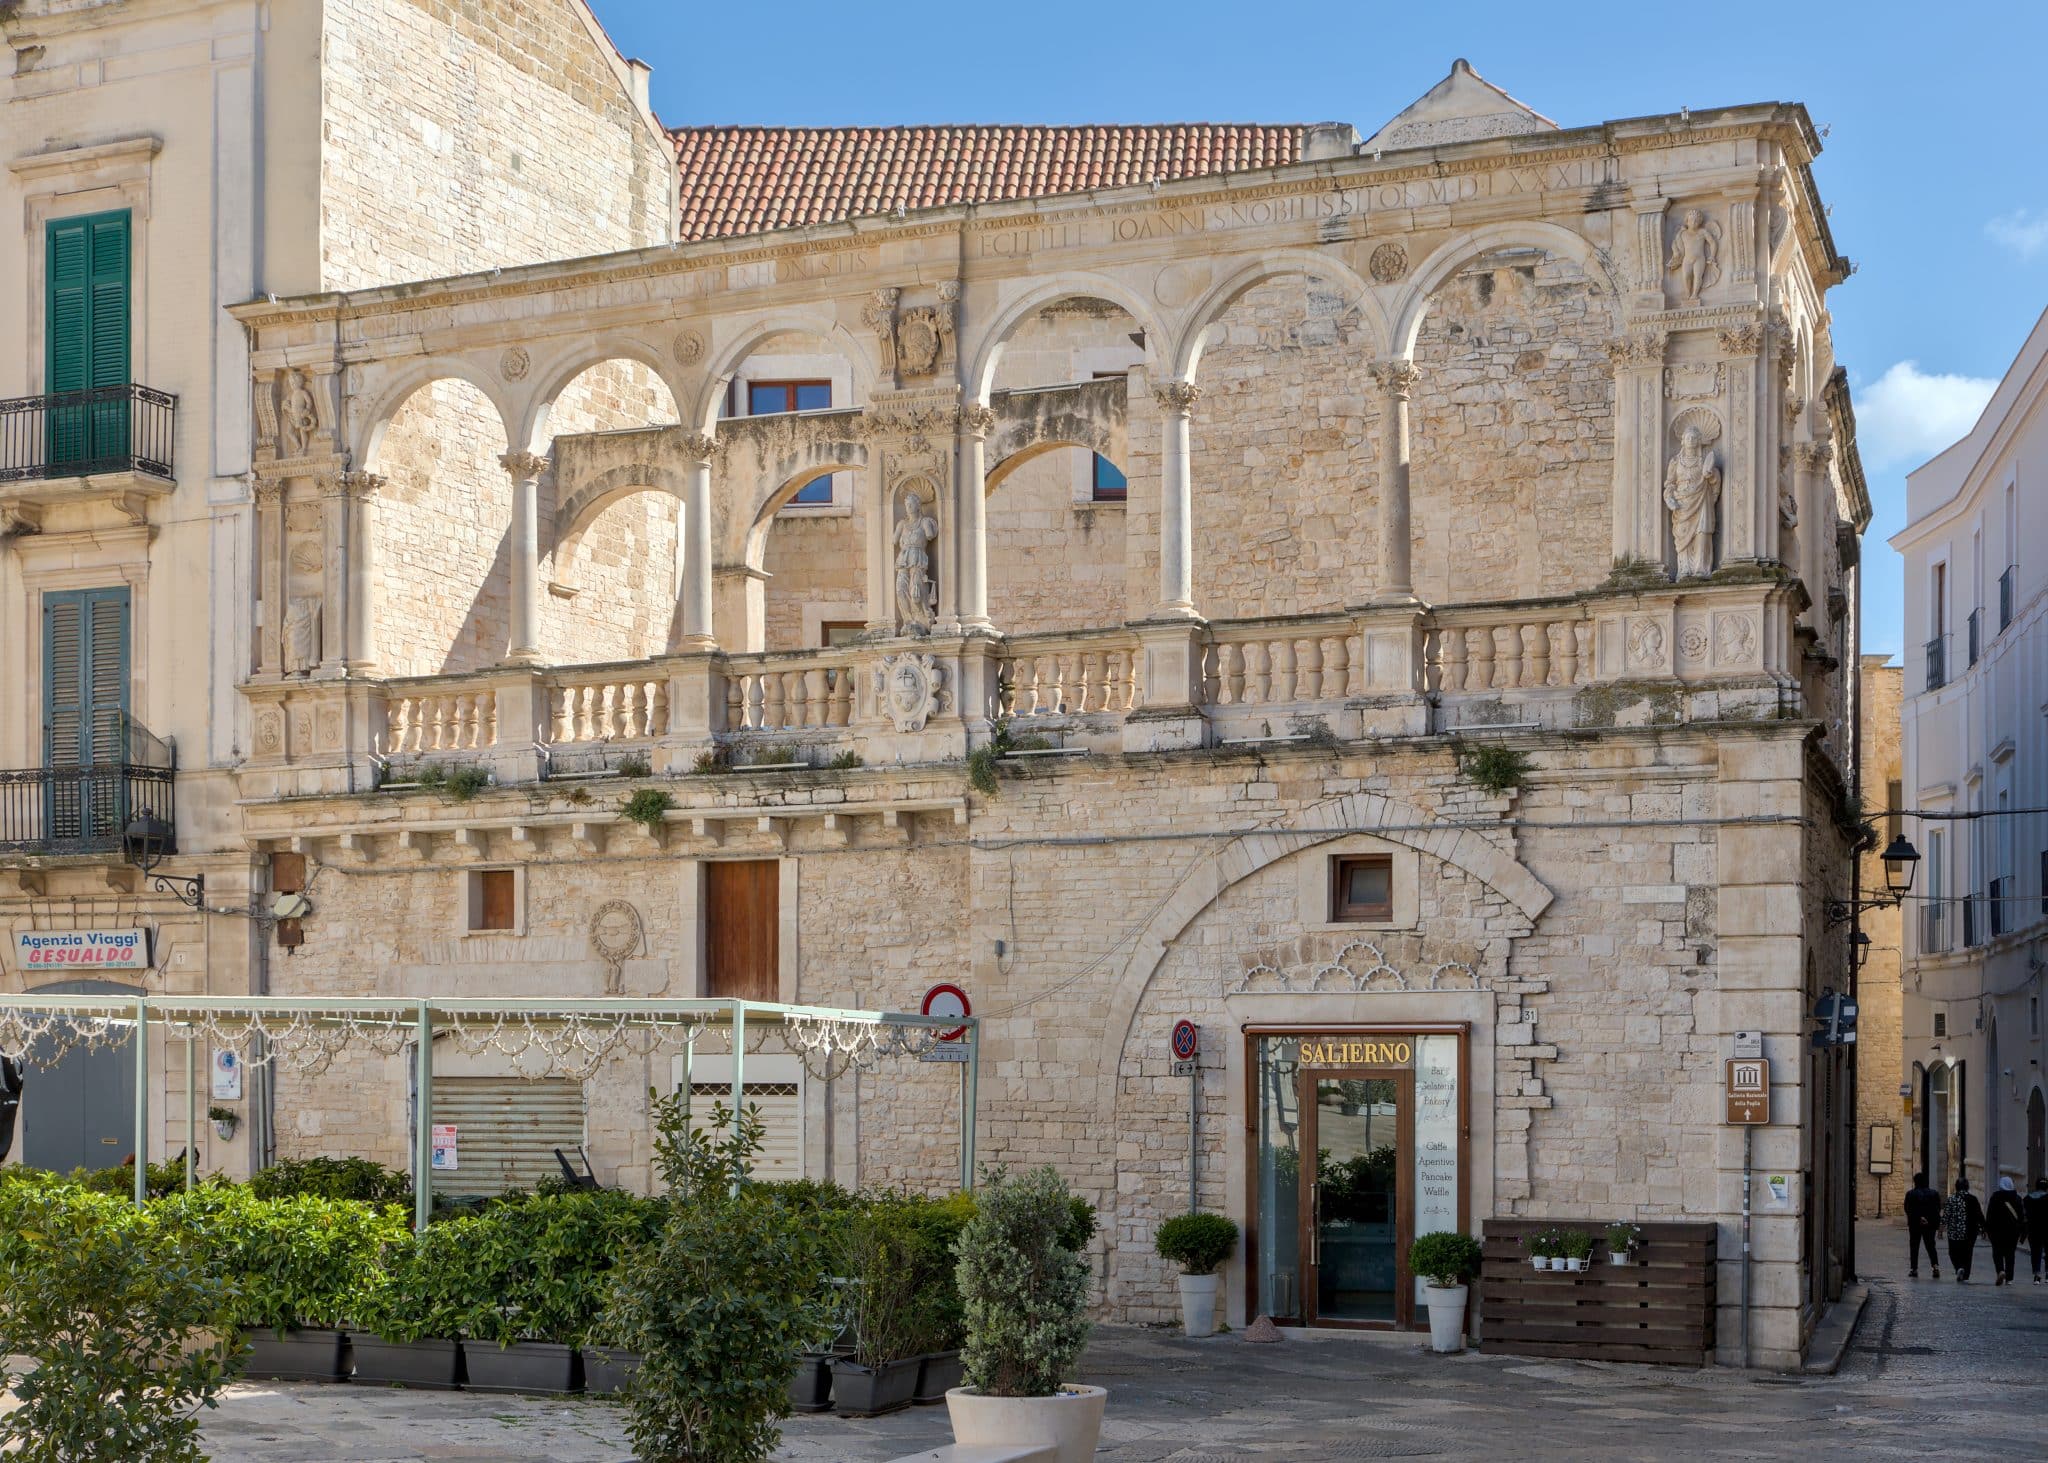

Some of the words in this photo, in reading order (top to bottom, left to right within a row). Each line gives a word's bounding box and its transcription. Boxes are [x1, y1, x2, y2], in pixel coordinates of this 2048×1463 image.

[21, 934, 83, 949] Agenzia
[87, 932, 138, 947] Viaggi
[29, 947, 133, 963] GESUALDO
[1524, 1010, 1535, 1021] 31
[1301, 1042, 1410, 1063] SALIERNO
[1421, 1171, 1453, 1181] Pancake
[1423, 1186, 1449, 1196] Waffle
